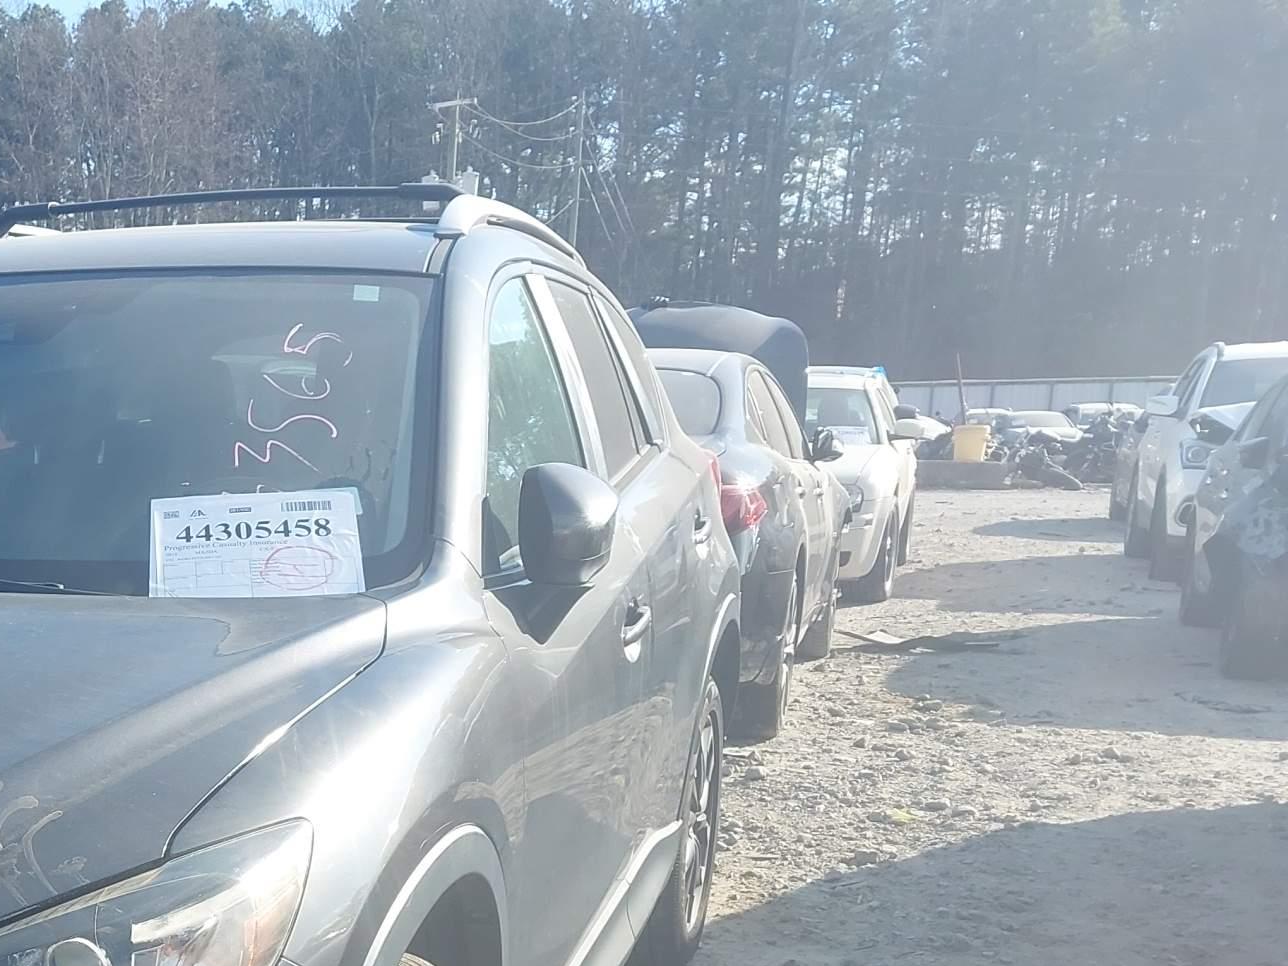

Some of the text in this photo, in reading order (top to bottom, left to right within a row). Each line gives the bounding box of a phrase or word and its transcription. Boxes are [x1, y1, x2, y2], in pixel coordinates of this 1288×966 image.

[222, 323, 353, 491] 3565
[176, 518, 332, 543] 44305458
[164, 539, 289, 553] Progressive Casualty Insurance
